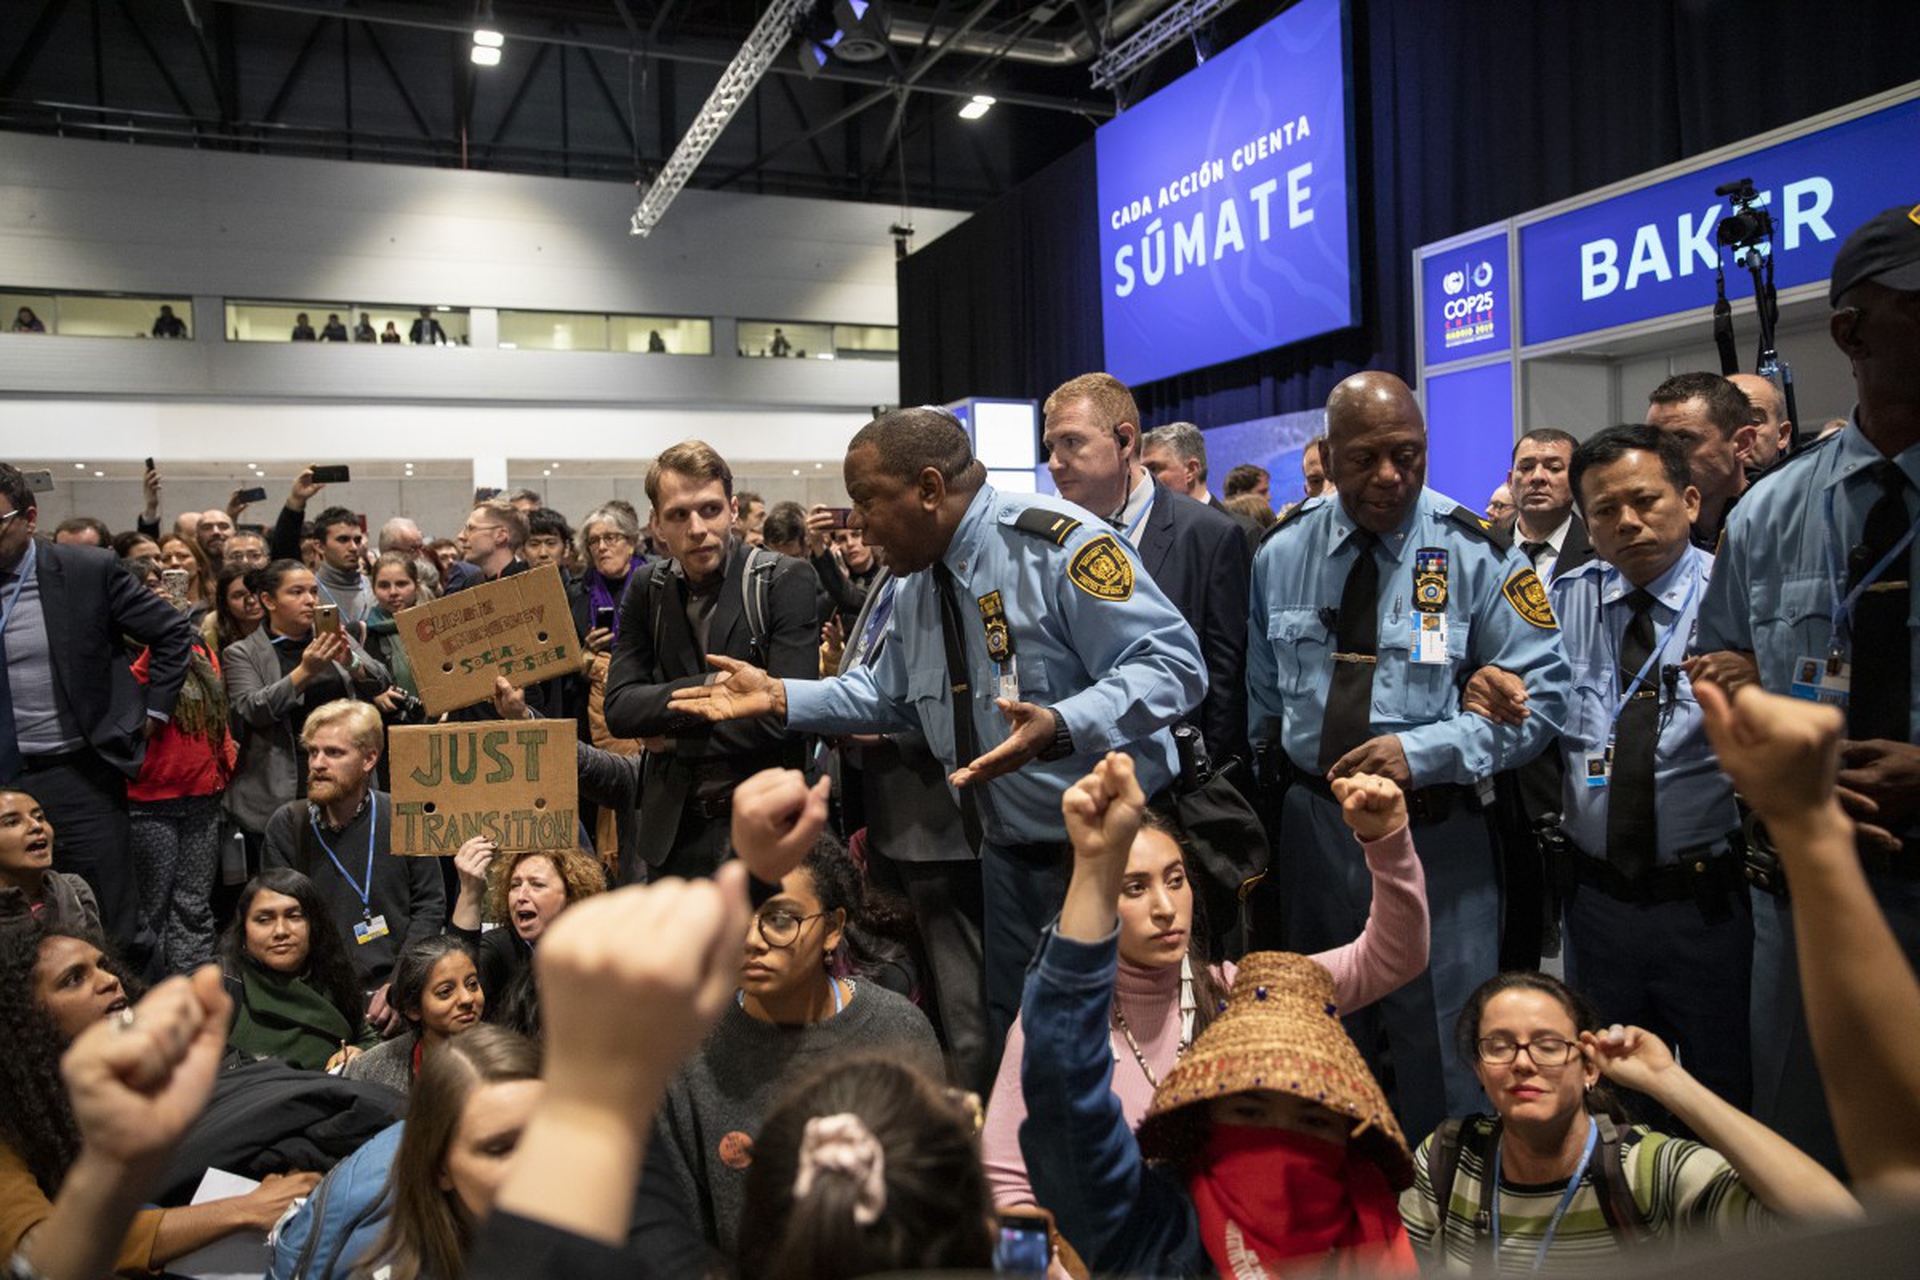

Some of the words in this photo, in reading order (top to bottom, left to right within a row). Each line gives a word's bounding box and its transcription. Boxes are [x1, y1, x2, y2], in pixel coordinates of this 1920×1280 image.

[1111, 196, 1152, 230] CADA
[1158, 158, 1224, 209] ACCIÓN
[1231, 115, 1311, 172] CUENTA
[1114, 161, 1315, 298] SÚMATE
[1443, 291, 1494, 320] COP25
[410, 729, 548, 787] JUST
